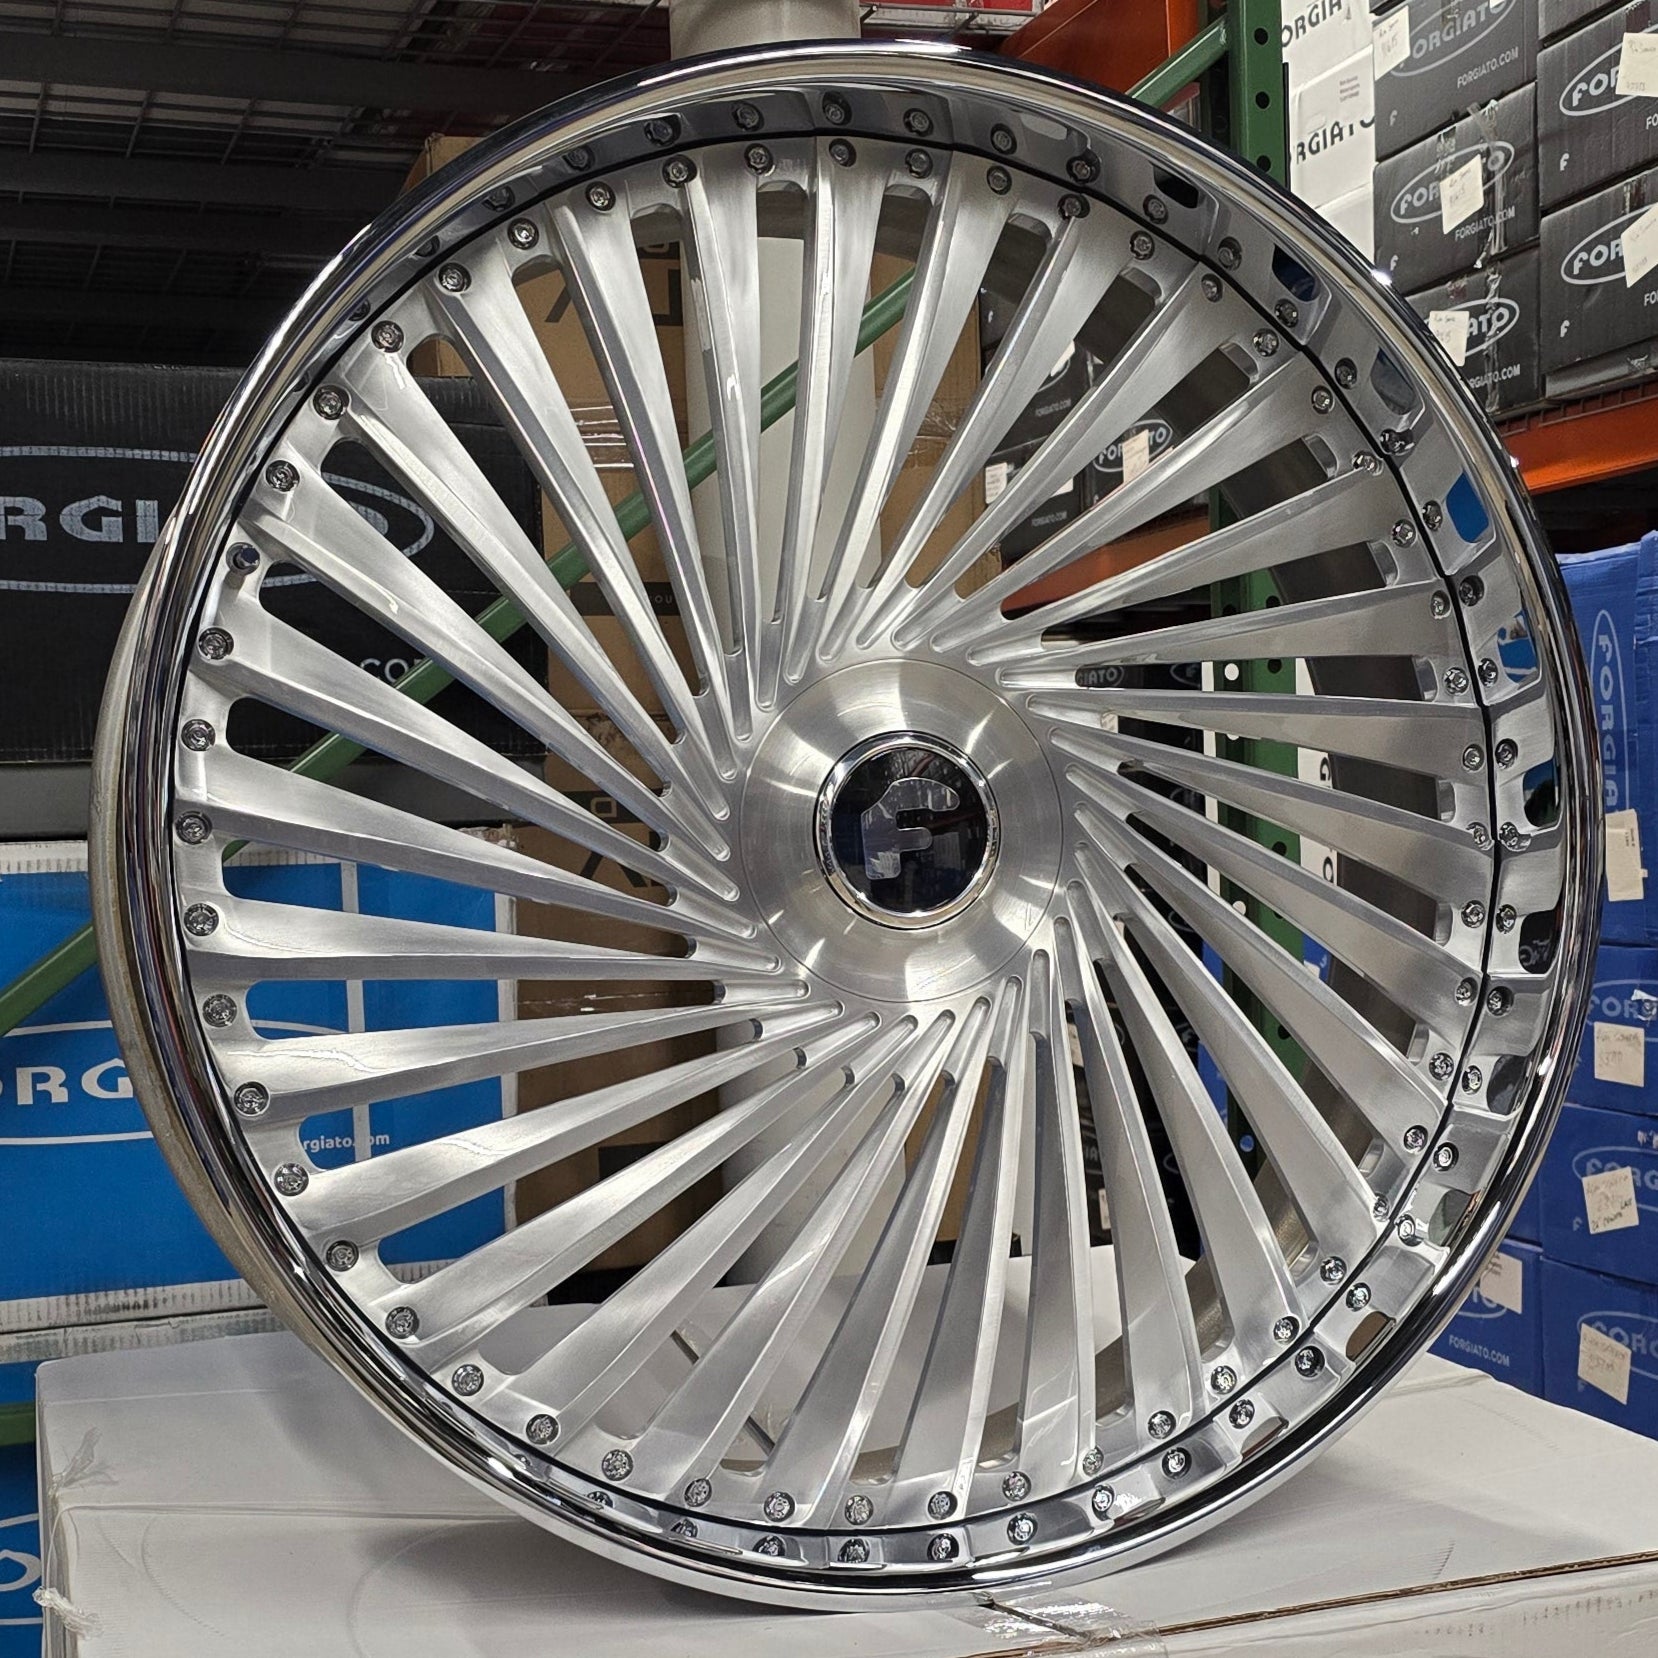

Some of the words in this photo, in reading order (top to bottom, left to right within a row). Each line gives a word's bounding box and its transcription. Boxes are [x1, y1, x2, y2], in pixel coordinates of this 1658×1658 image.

[1457, 46, 1519, 88] FORGIATO.COM
[1455, 205, 1516, 241] FORGIATO.COM
[1449, 1334, 1510, 1367] FORGIATO.COM
